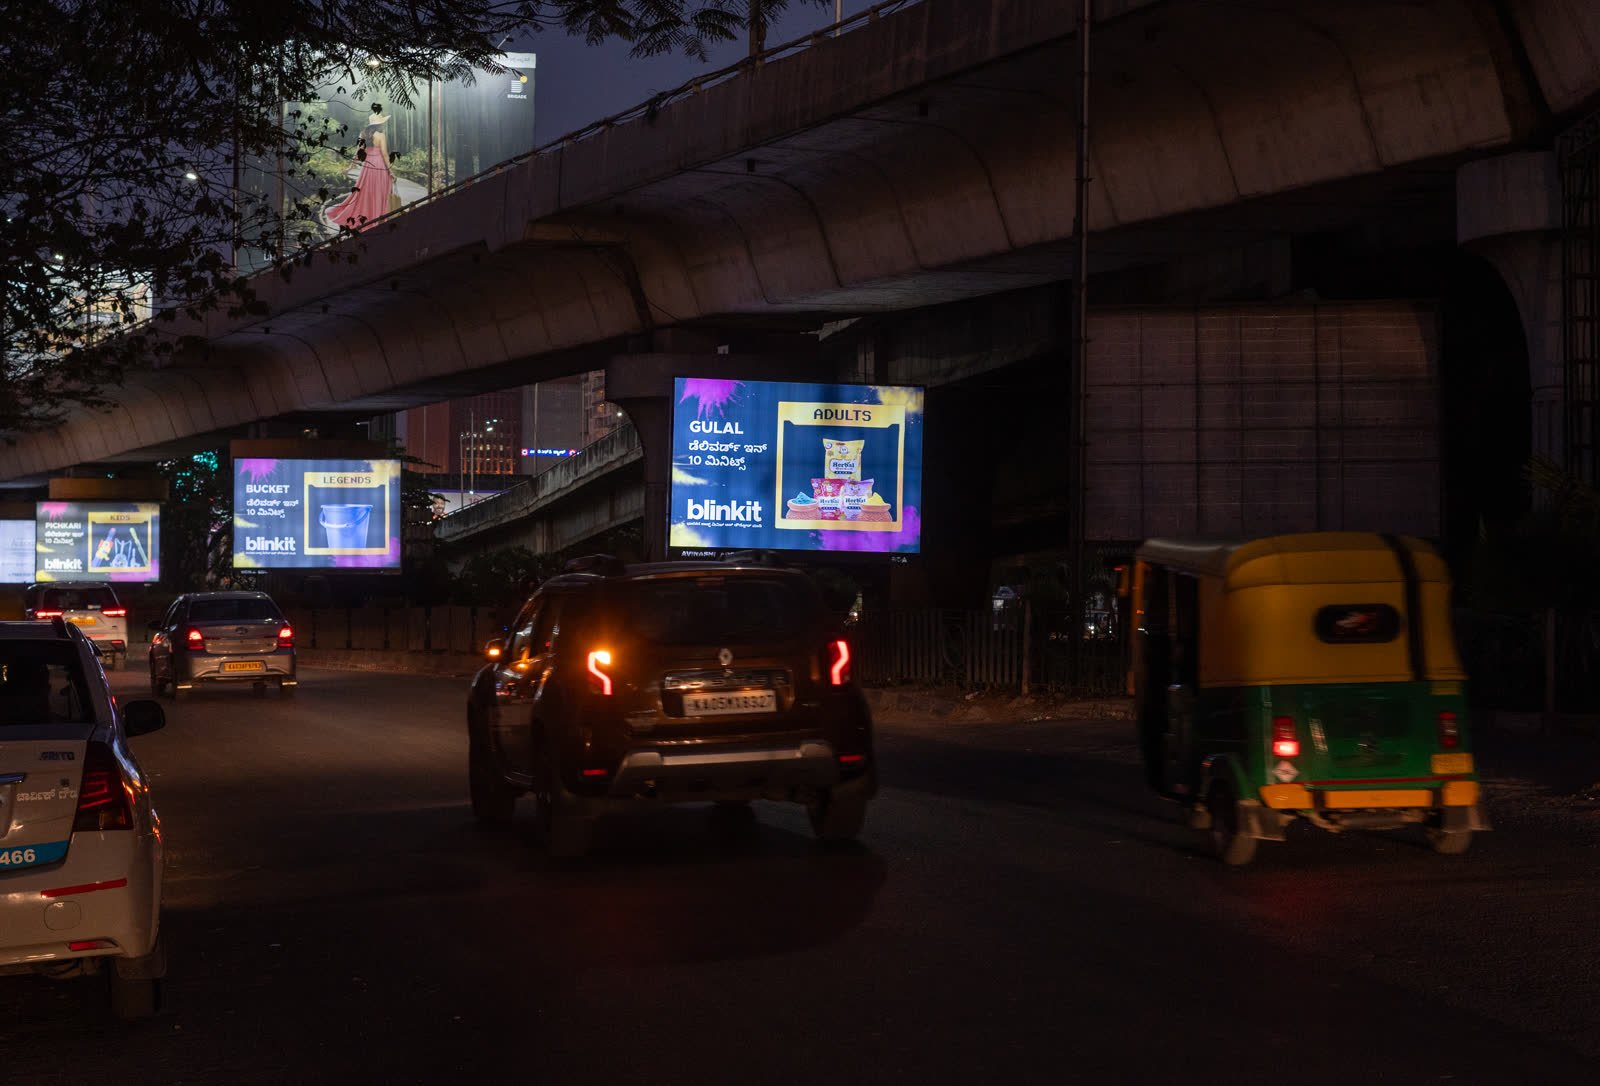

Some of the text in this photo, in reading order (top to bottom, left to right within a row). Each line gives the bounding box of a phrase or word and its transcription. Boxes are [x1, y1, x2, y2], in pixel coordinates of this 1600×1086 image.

[813, 408, 872, 422] ADULTS
[689, 420, 744, 435] GULAL
[688, 439, 768, 453] ಡೆಲಿವರ್ಡ್ ಇನ್
[688, 454, 746, 471] 10 ಮಿನಿಟ್ಸ್
[323, 476, 372, 484] LEGENDS
[246, 484, 290, 494] BUCKET
[246, 508, 256, 516] 10
[687, 499, 762, 523] blinkit
[245, 536, 296, 551] blinkit
[44, 558, 83, 570] blinkit
[0, 848, 36, 865] 466
